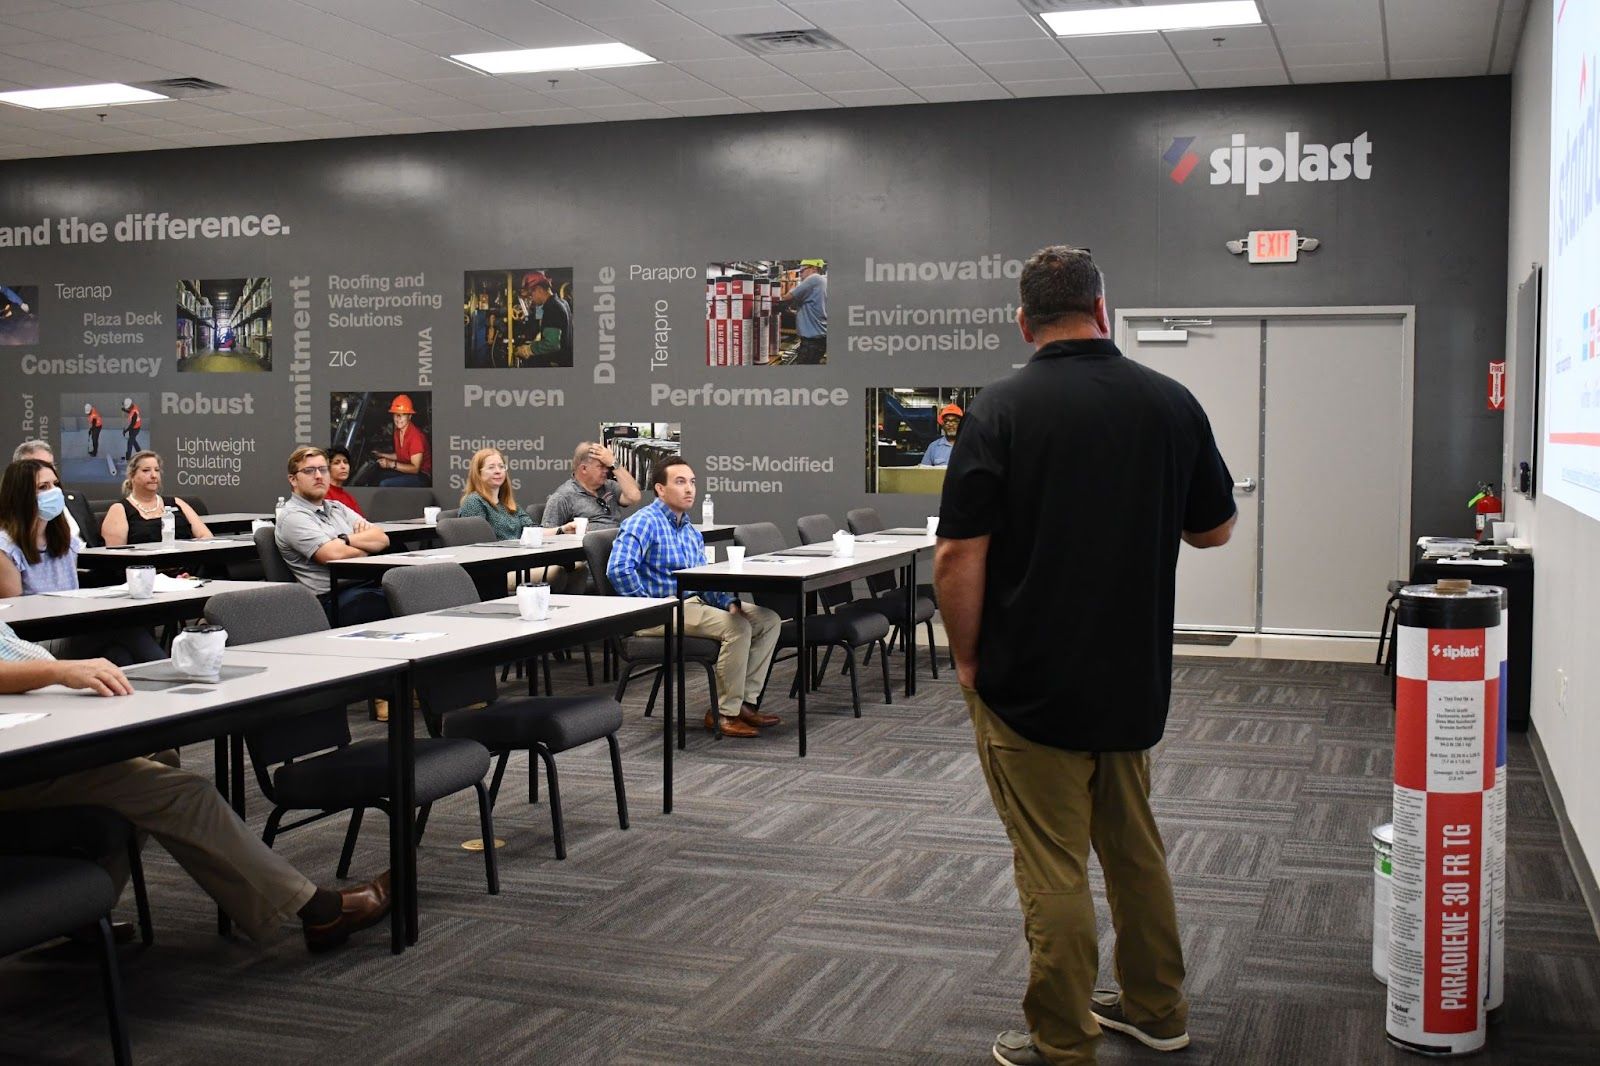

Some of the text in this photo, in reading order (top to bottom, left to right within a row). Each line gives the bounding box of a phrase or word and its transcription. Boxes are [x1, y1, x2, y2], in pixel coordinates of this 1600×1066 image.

[1209, 131, 1372, 195] siplast
[0, 213, 290, 247] and the difference.
[1257, 232, 1290, 257] EXIT
[630, 265, 697, 283] Parapro
[865, 254, 1024, 282] Innovatio
[54, 283, 112, 301] Teranap
[328, 272, 424, 293] Roofing and
[328, 292, 442, 311] Waterproofing
[83, 312, 162, 326] Plaza Deck
[328, 313, 403, 328] Solutions
[594, 266, 616, 384] Durable
[848, 303, 1018, 326] Environment
[83, 331, 144, 347] Systems
[651, 299, 671, 371] Terapro
[848, 329, 1000, 356] responsible
[21, 354, 162, 377] Consistency
[289, 276, 312, 446] mmitment
[328, 351, 357, 367] ZIC
[419, 327, 432, 386] PMMA
[161, 392, 254, 414] Robust
[464, 385, 564, 407] Proven
[651, 383, 849, 406] Performance
[22, 393, 34, 431] Roof
[176, 437, 255, 454] Lightweight
[449, 436, 545, 453] Engineered
[177, 454, 241, 472] Insulating
[505, 456, 573, 471] embran
[705, 456, 834, 473] SBS-Modified
[177, 471, 240, 486] Concrete
[706, 477, 782, 493] Bitumen
[1442, 645, 1479, 660] siplast
[1441, 824, 1471, 1010] PARADIENE 30 FR TG
